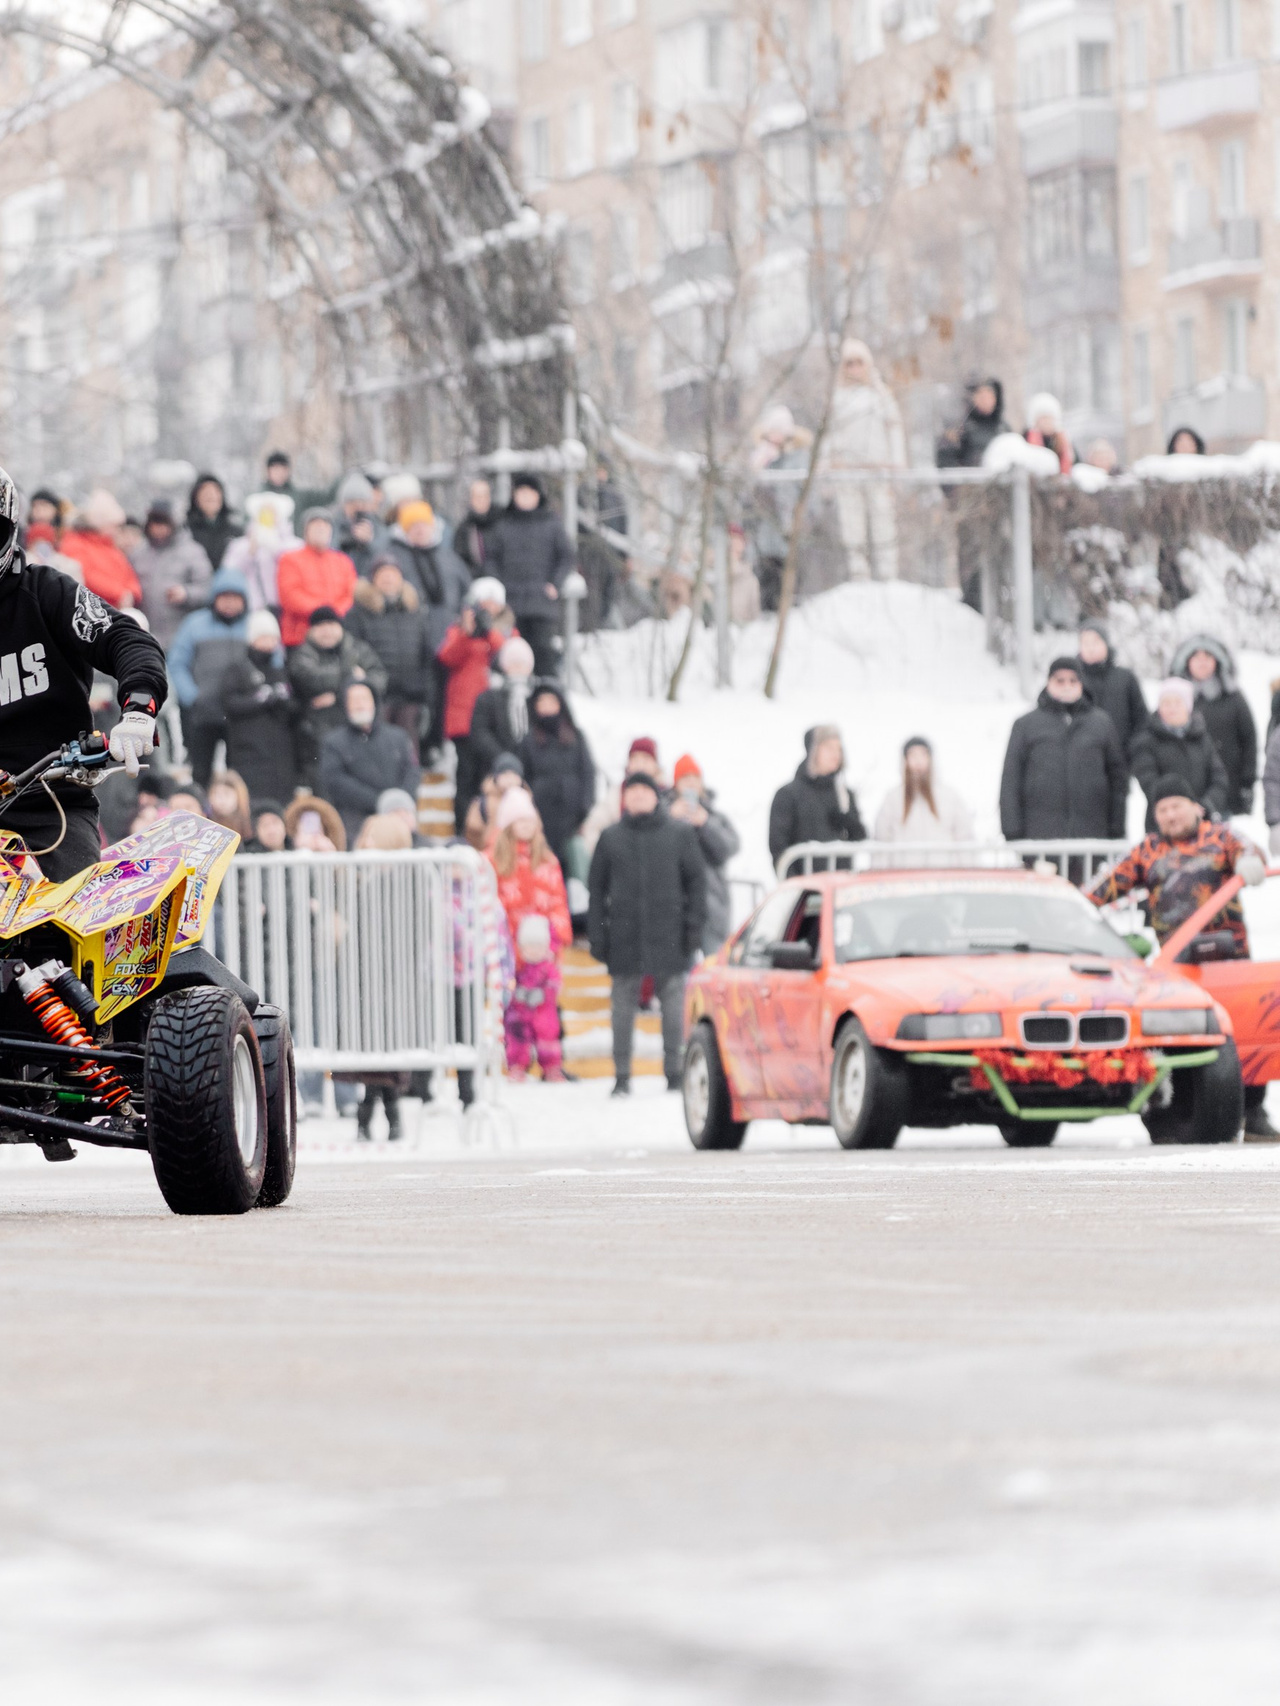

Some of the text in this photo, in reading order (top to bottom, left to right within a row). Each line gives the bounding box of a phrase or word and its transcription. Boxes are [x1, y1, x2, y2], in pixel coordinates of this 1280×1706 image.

[72, 876, 107, 904] FOX
[114, 964, 140, 975] FOX
[112, 984, 138, 994] GAV
